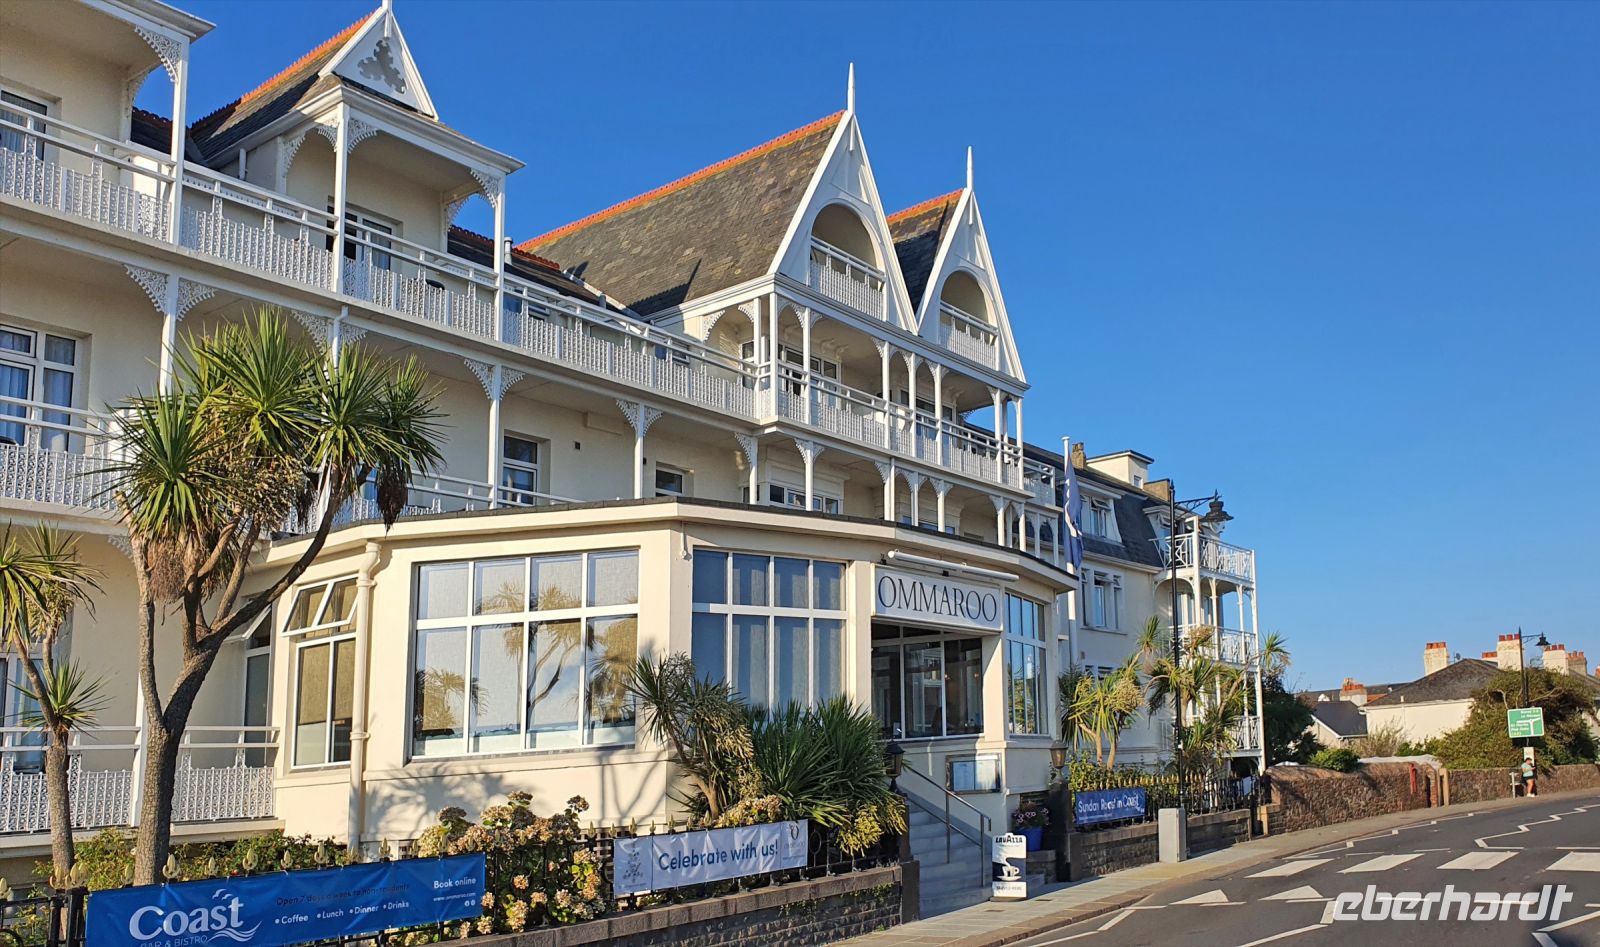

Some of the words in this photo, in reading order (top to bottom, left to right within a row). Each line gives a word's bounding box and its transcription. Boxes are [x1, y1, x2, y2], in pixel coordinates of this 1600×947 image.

[878, 575, 997, 622] OMMAROO
[1078, 800, 1100, 813] Sunday
[1123, 794, 1139, 808] Coast
[995, 835, 1023, 843] LAVAZZA
[658, 850, 727, 871] Celebrate
[731, 843, 757, 864] with
[761, 839, 778, 857] us!
[433, 878, 453, 889] Book
[454, 876, 477, 887] online
[129, 896, 245, 941] Coast
[281, 914, 309, 924] Coffee
[322, 909, 344, 919] Lunch
[354, 905, 379, 915] Dinner
[387, 901, 410, 910] Drinks
[174, 935, 208, 947] BISTRO
